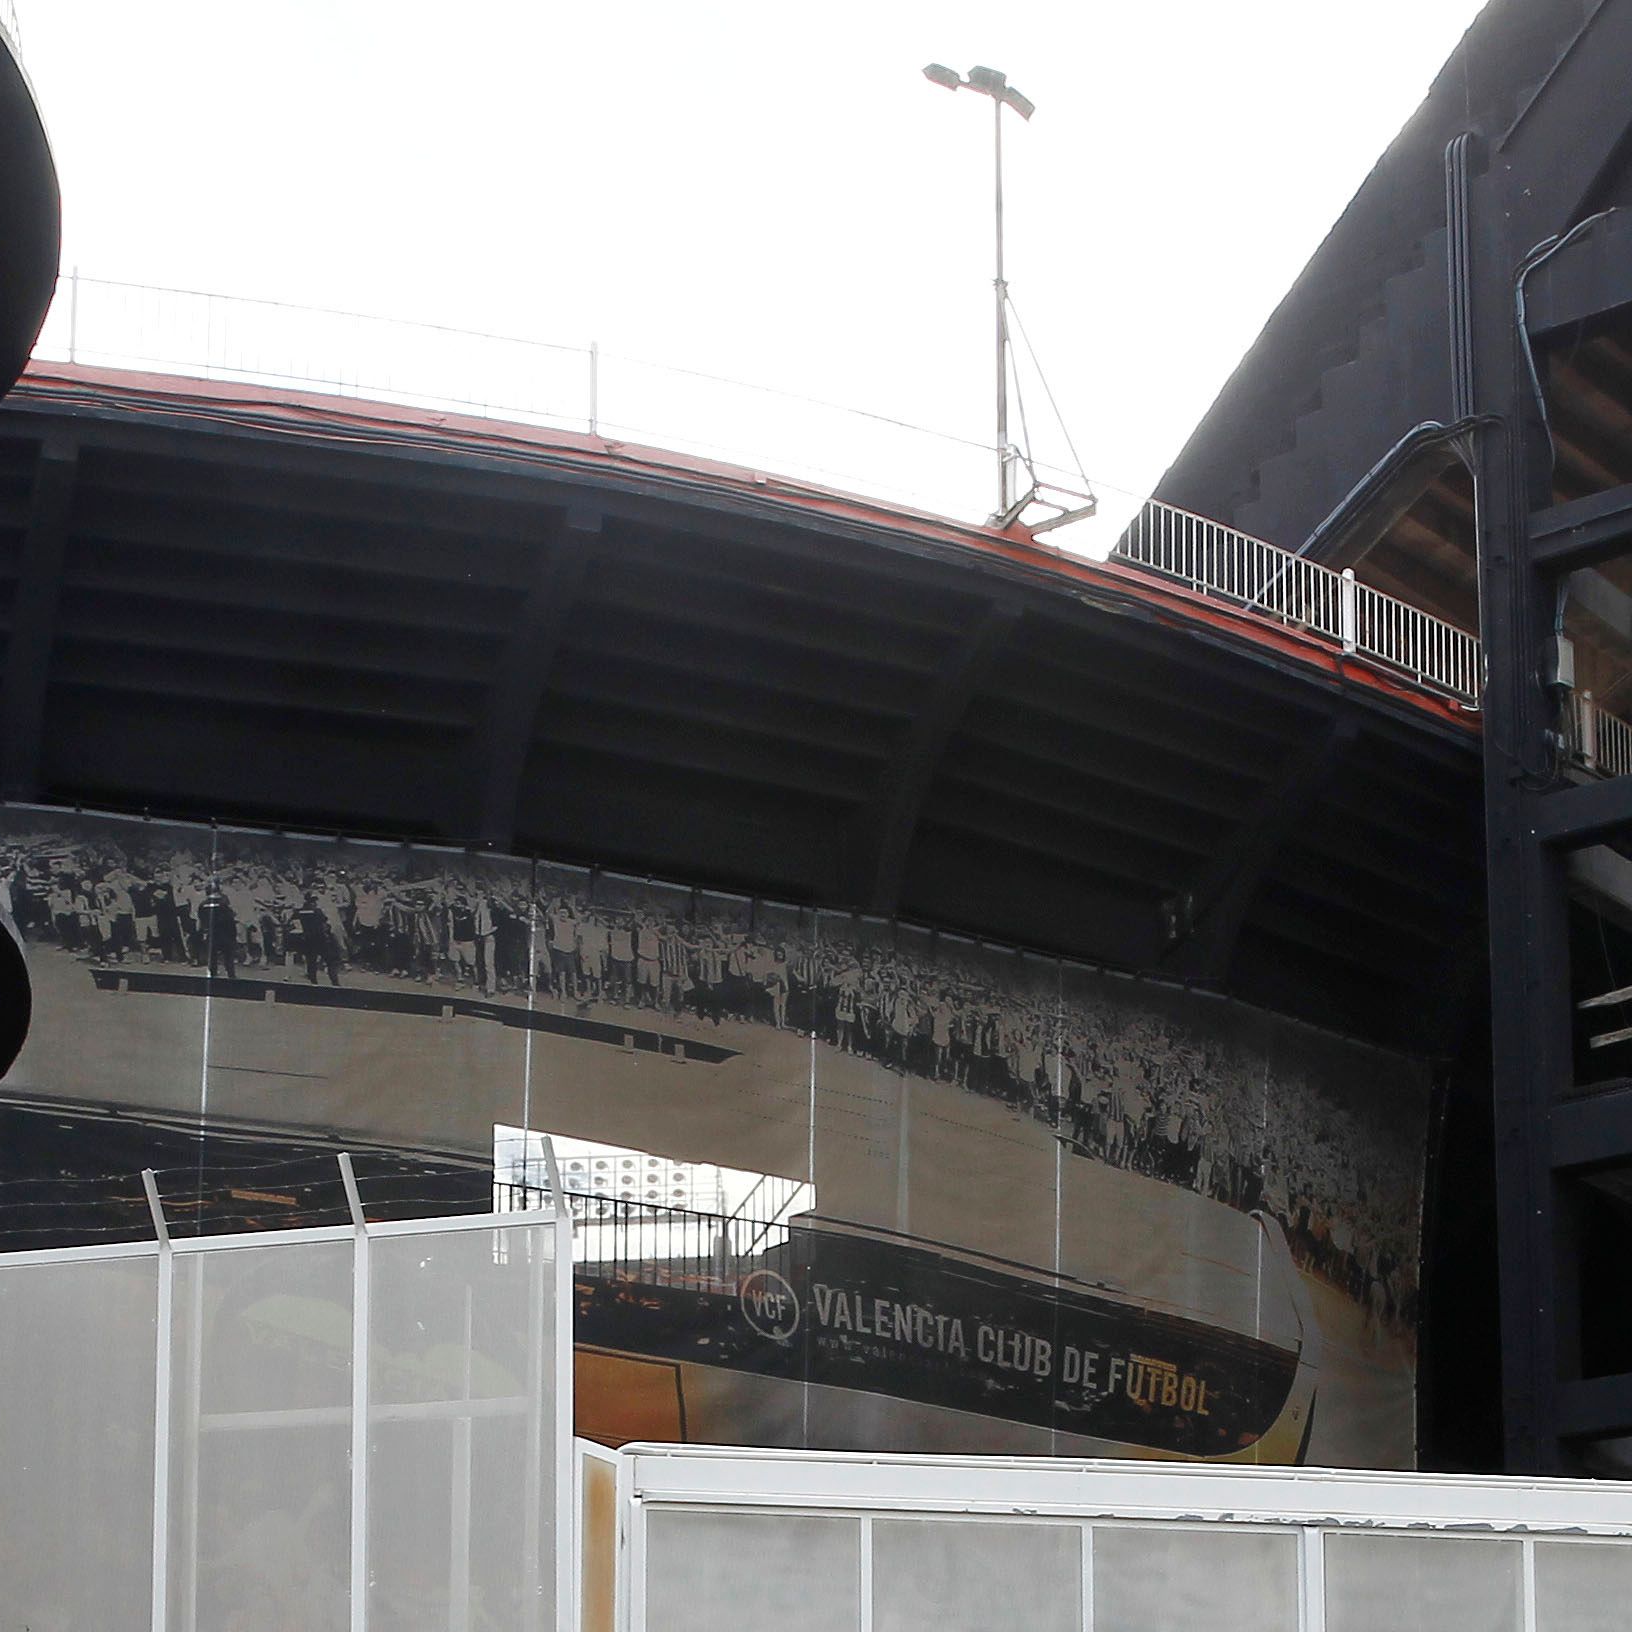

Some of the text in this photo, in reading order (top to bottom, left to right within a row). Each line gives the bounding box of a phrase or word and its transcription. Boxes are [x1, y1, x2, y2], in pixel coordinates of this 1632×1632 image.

[752, 1290, 786, 1321] VCF
[812, 1283, 966, 1358] VALENCIA
[976, 1324, 1052, 1377] CLUB
[1062, 1346, 1099, 1389] DE
